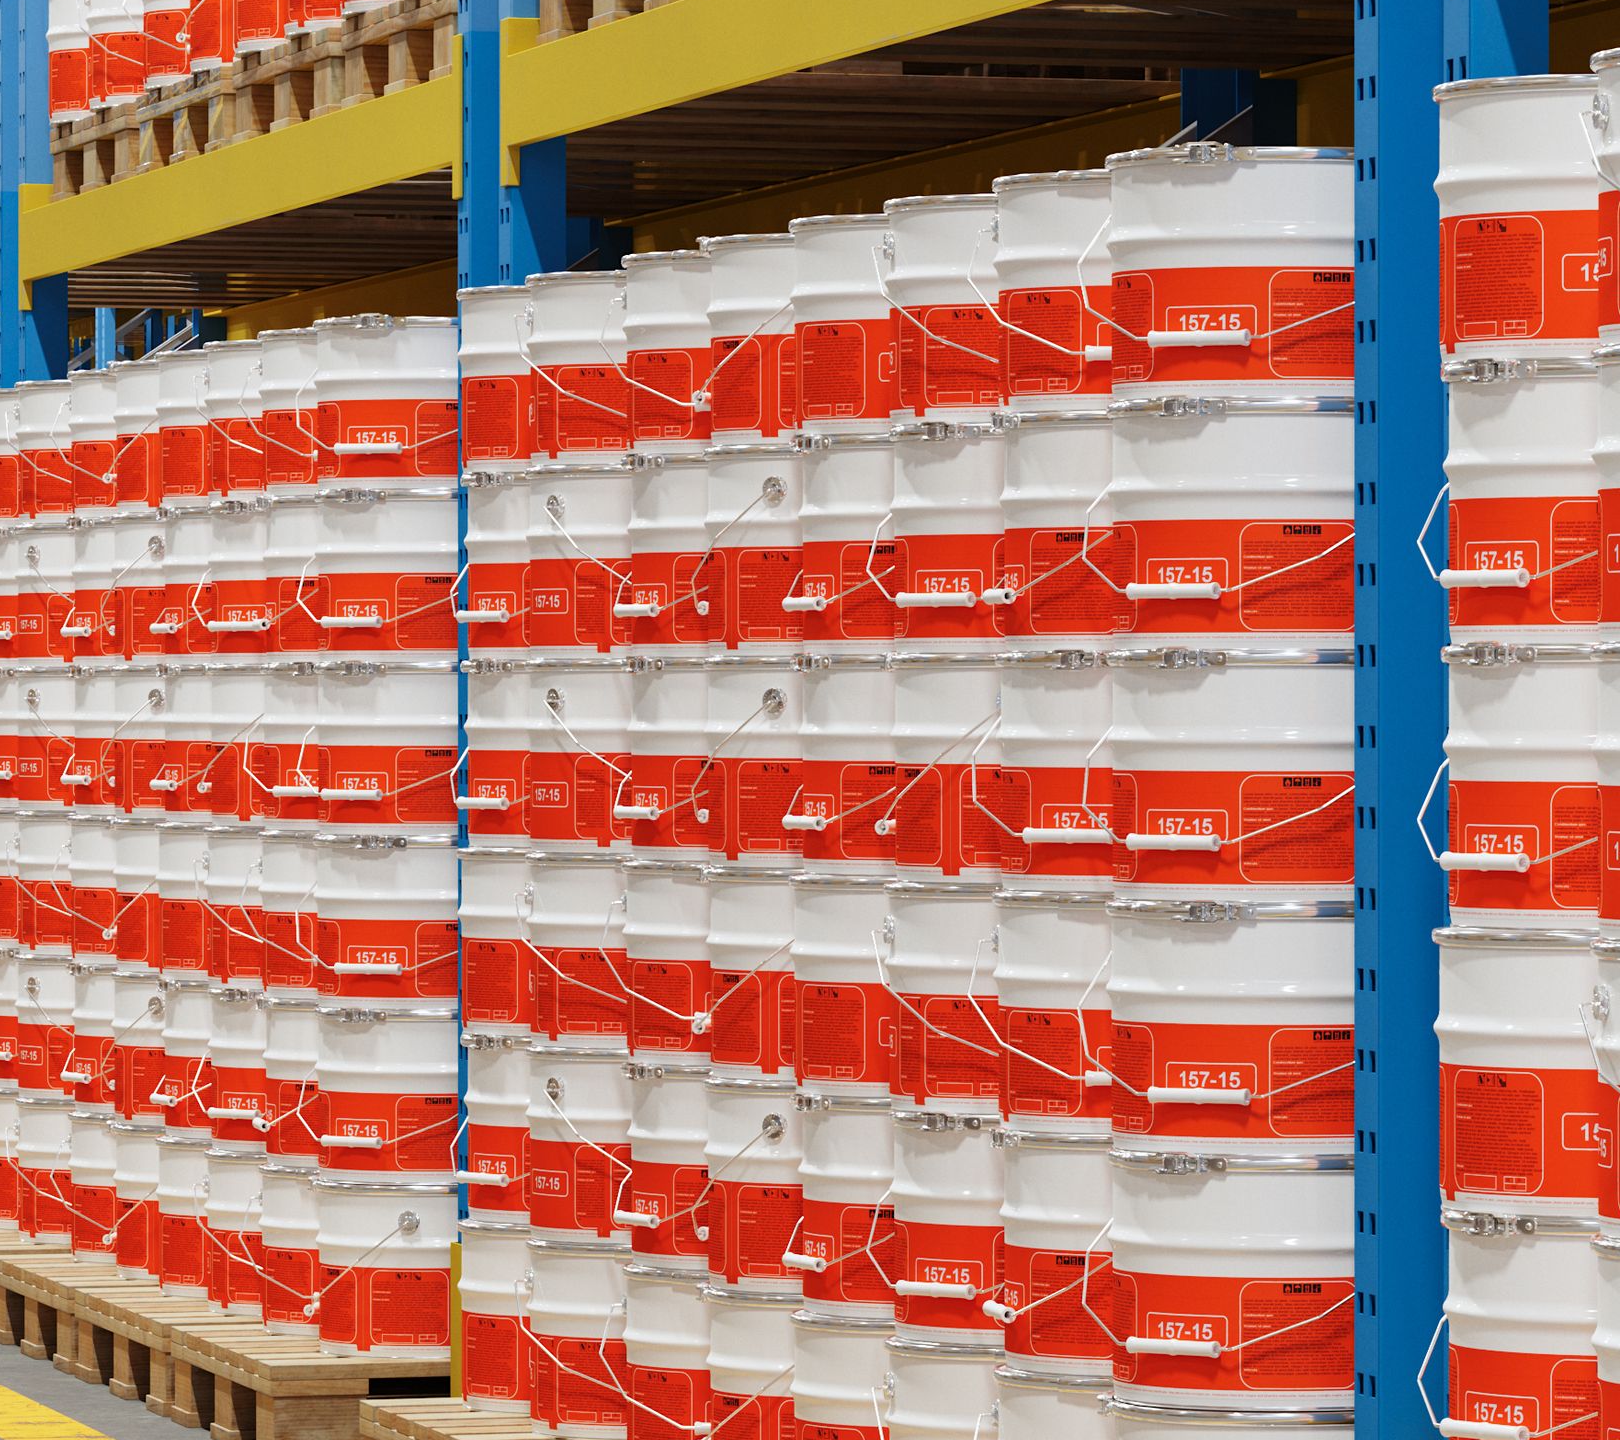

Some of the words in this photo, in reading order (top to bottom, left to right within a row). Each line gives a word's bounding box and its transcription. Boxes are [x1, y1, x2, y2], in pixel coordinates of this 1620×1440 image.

[1177, 314, 1238, 330] 157-15
[1474, 551, 1524, 569] 157-15
[1158, 567, 1212, 583] 157-15
[924, 578, 970, 592] 157-15
[1158, 818, 1212, 834] 157-15
[1474, 834, 1524, 853] 157-15
[1180, 1071, 1240, 1088] 157-15
[924, 1266, 970, 1283] 157-15
[1157, 1322, 1212, 1340] 157-15
[1474, 1402, 1523, 1423] 157-15
